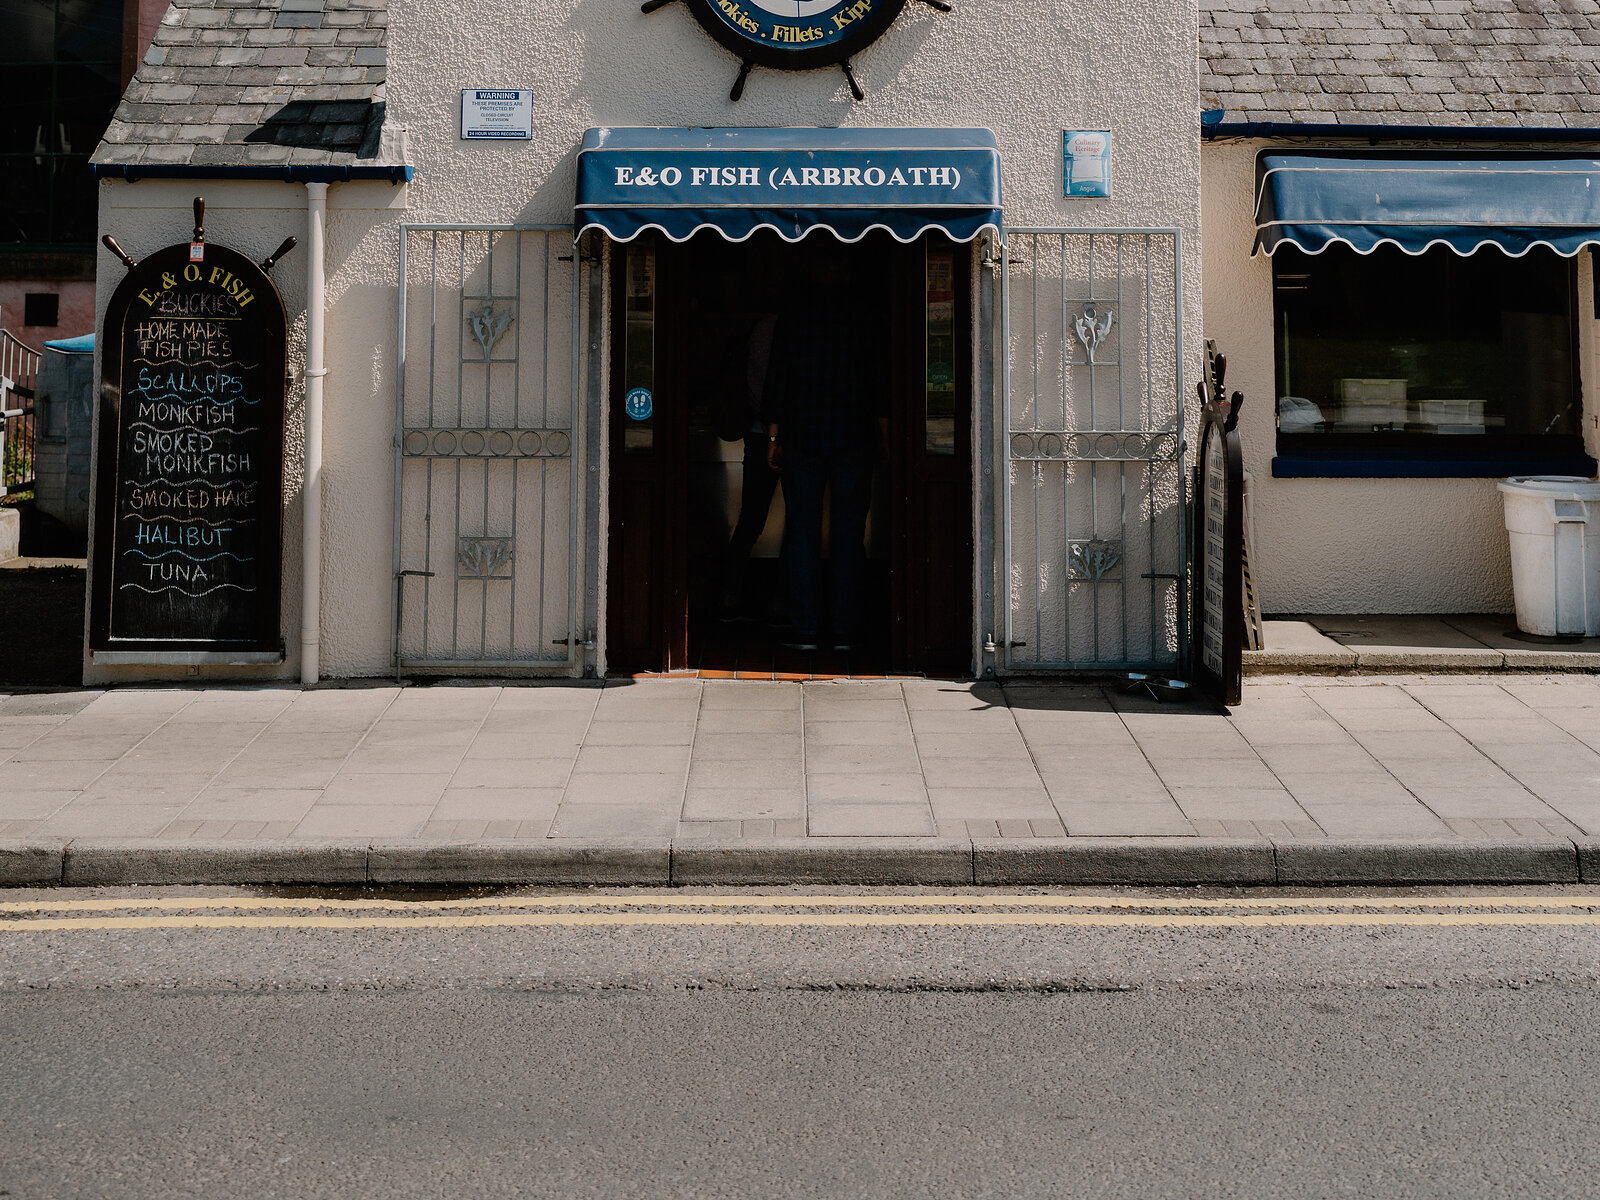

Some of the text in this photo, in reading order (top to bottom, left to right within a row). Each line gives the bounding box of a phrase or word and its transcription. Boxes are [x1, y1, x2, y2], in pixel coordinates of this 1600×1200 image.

[770, 25, 824, 43] Fillets
[614, 166, 962, 190] E&O FISH (ARBROATH)
[138, 264, 255, 307] E. & O. FISH
[158, 290, 238, 315] BUCKIES
[134, 322, 228, 340] HOME MADE
[140, 340, 232, 358] FISH PIES
[137, 367, 243, 393] SCALLOPS
[139, 403, 235, 424] MONKFISH
[134, 431, 213, 453] SMOKED
[146, 453, 250, 475] MONKFISH
[130, 489, 256, 509] SMOKED HAKE
[135, 523, 232, 546] HALIBUT
[142, 563, 208, 581] TUNA
